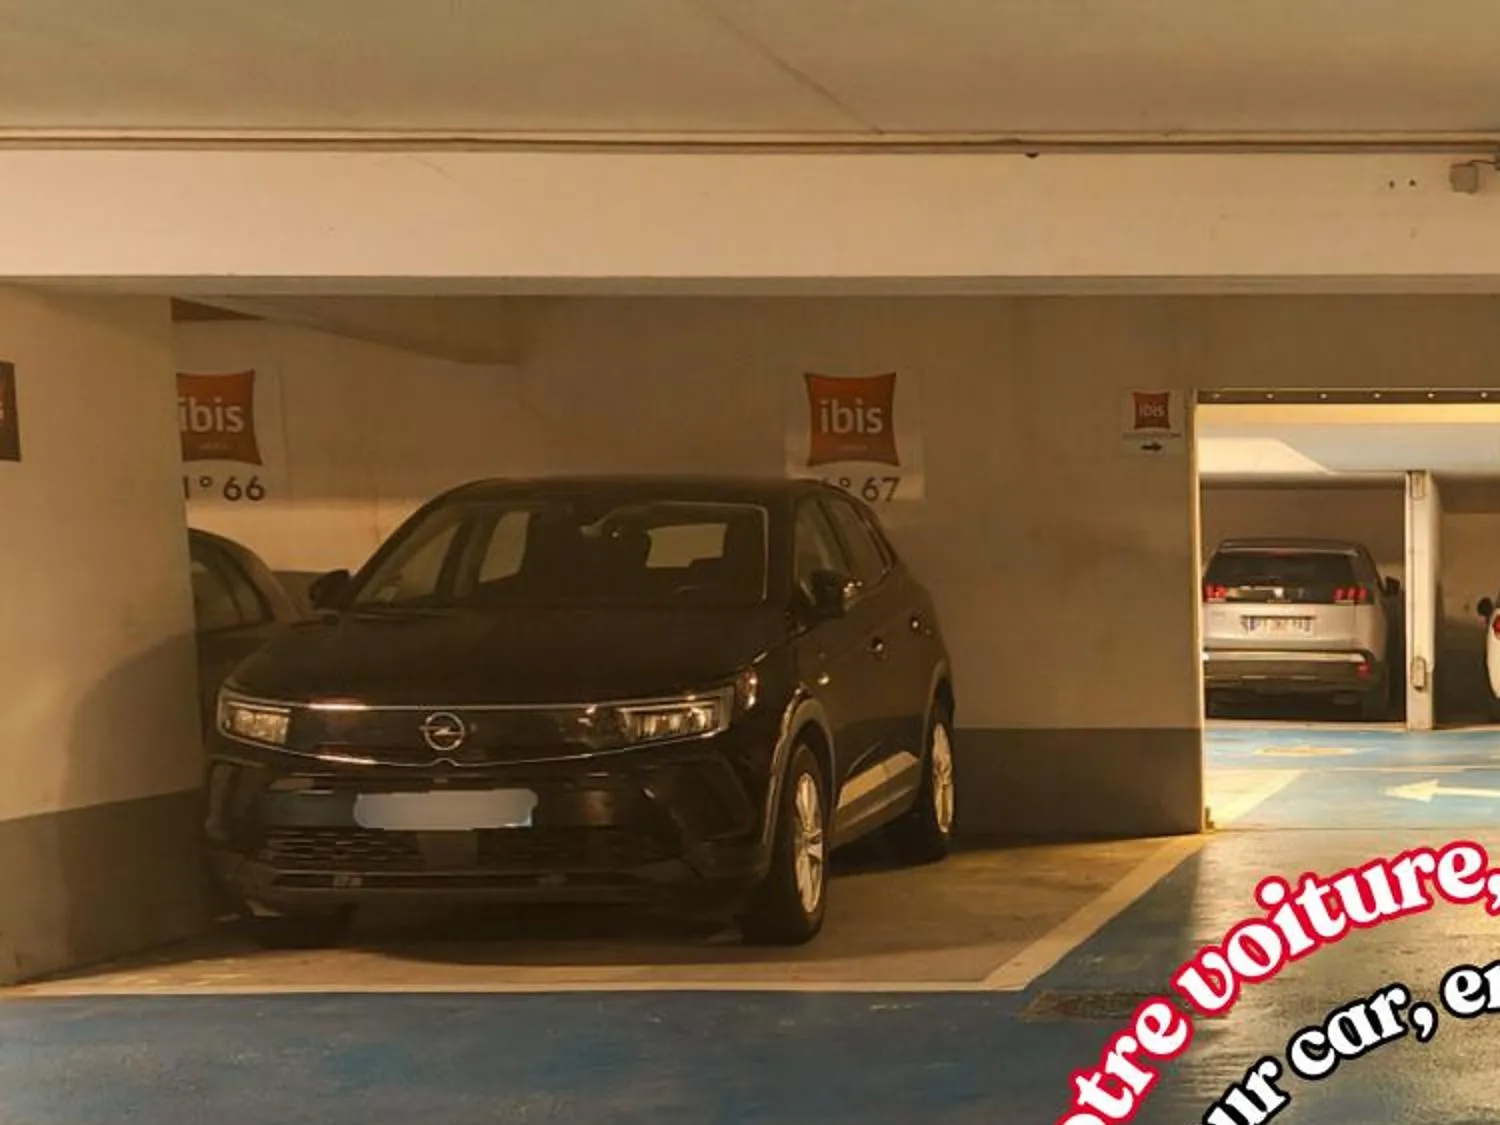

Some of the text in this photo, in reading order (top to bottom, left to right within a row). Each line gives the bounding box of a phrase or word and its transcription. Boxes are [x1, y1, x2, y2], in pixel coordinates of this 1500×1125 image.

[179, 396, 244, 433] ibis
[820, 398, 883, 434] ibis
[223, 475, 265, 502] 66
[862, 476, 900, 502] 67
